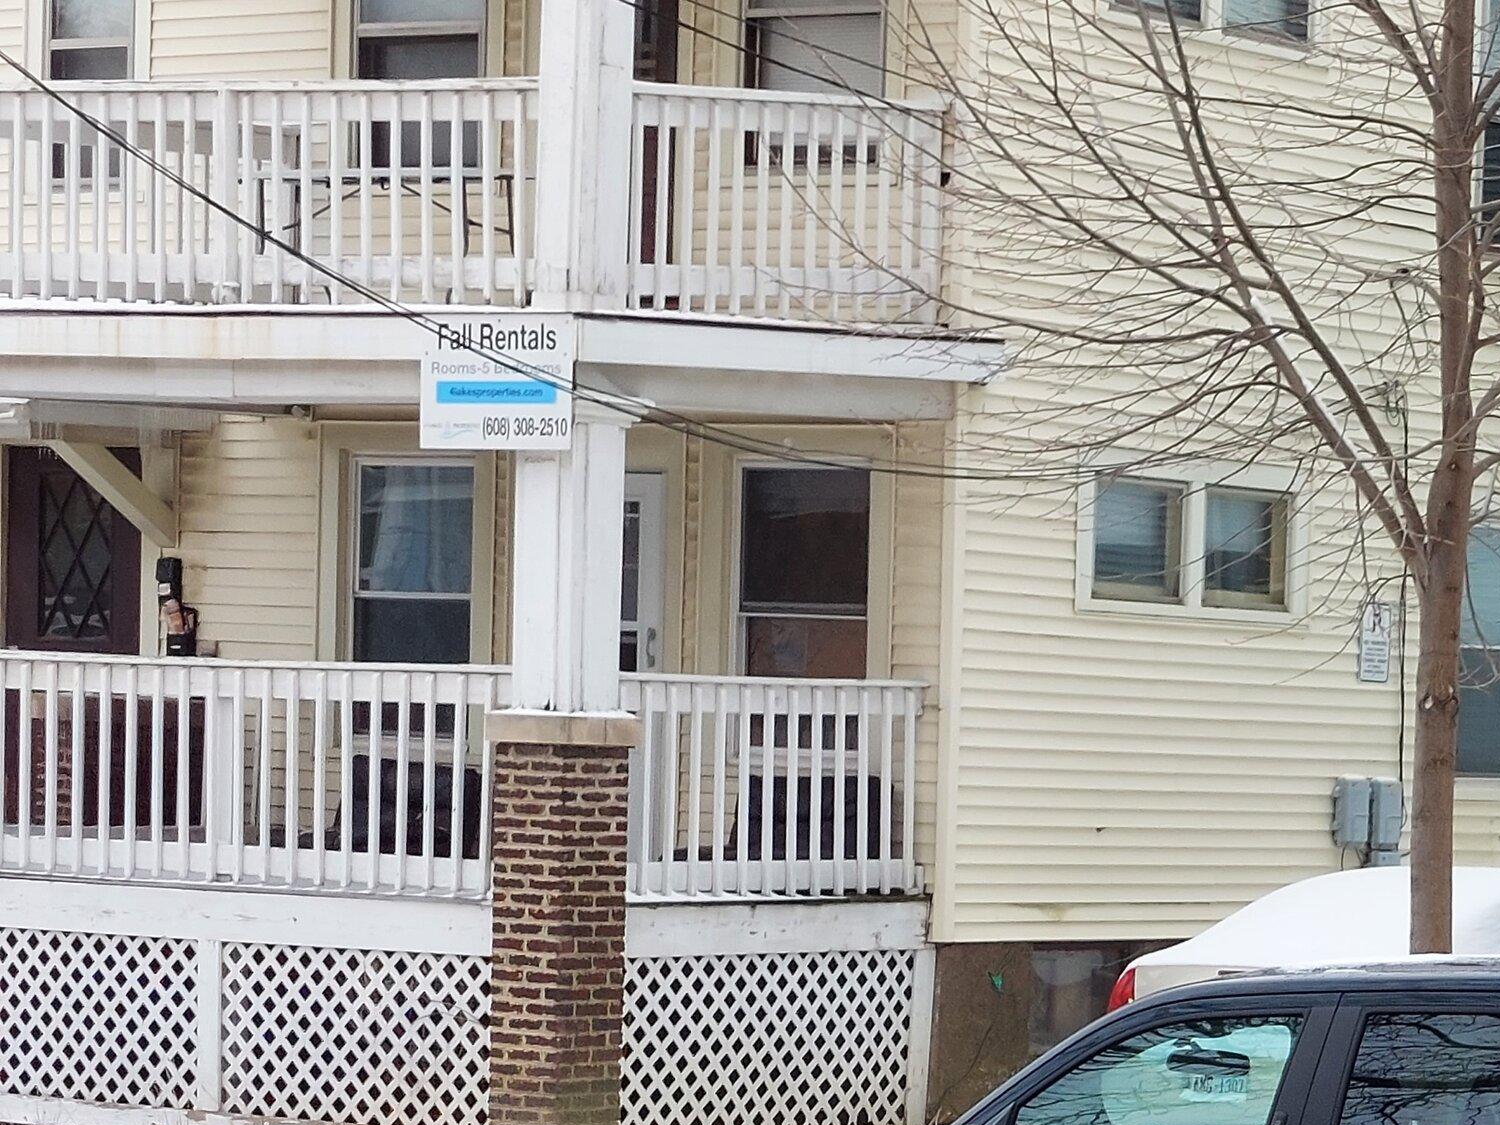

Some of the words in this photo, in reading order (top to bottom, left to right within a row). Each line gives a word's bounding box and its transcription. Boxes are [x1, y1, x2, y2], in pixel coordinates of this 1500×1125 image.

[438, 323, 472, 350] Fall
[481, 323, 557, 350] Rentals
[431, 361, 489, 374] Rooms-5
[482, 416, 510, 440] (608)
[514, 417, 568, 436] 308-2510
